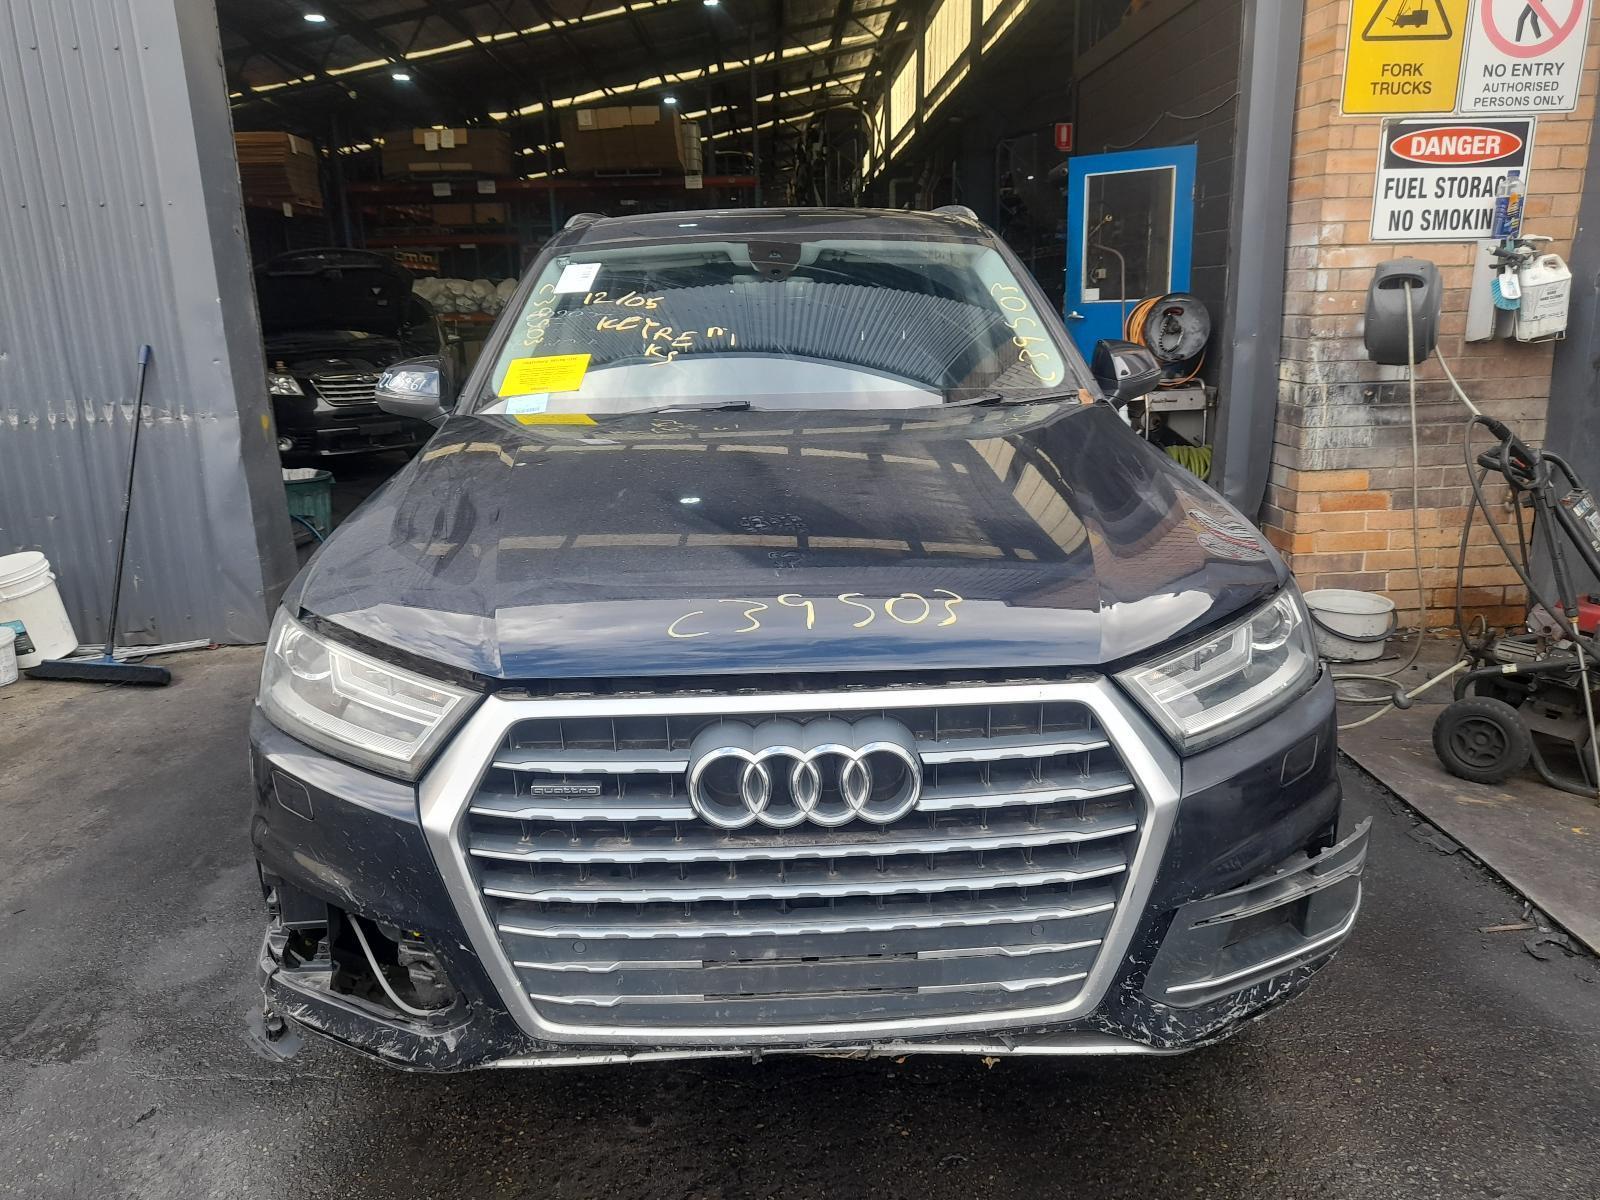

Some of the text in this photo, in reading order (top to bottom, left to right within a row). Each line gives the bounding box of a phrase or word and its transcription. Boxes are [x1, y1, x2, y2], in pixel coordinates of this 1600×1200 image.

[1381, 63, 1424, 77] FORK
[1482, 62, 1565, 78] NO ENTRY
[1370, 81, 1432, 95] TRUCKS
[1482, 81, 1559, 93] AUTHORISED
[1474, 95, 1565, 107] PERSONS ONLY
[1410, 135, 1502, 156] DANGER
[1384, 175, 1508, 200] FUEL STORA
[1388, 209, 1414, 232] NO
[1420, 208, 1494, 231] SMOKIN
[583, 290, 665, 310] 12/05
[667, 588, 964, 638] C39503
[534, 786, 597, 796] quattro
